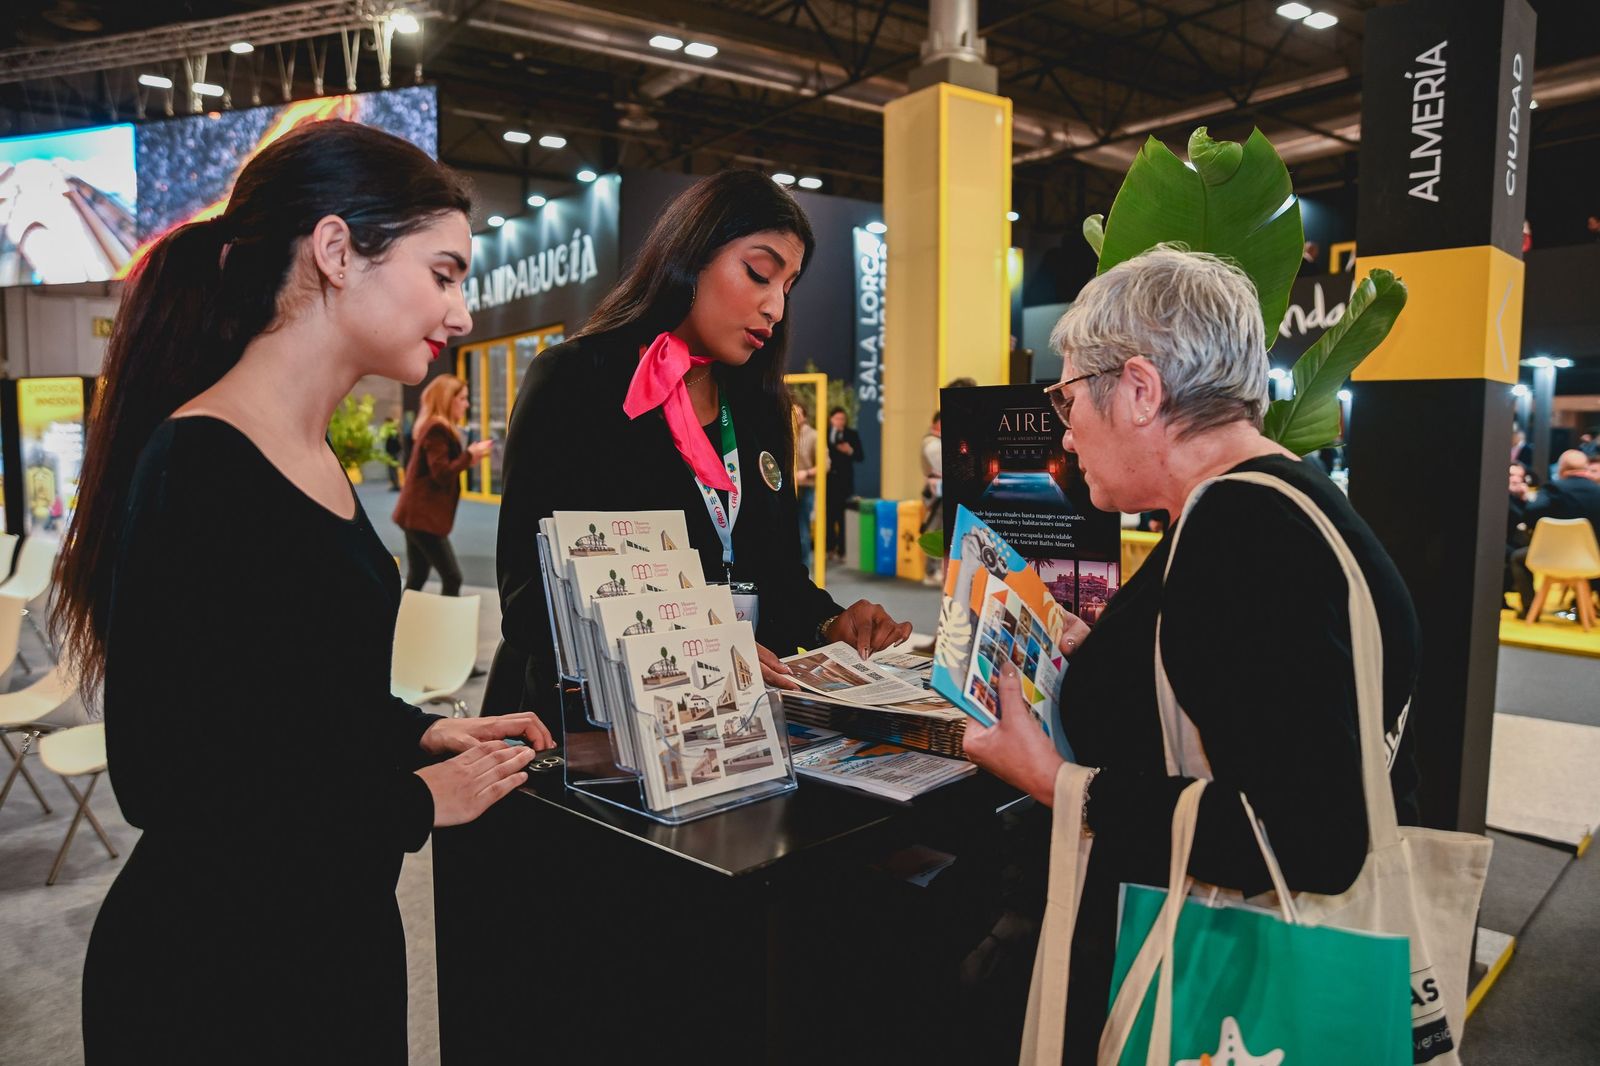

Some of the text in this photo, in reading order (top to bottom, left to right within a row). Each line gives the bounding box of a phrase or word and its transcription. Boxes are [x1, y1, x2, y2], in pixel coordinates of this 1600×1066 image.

[1404, 40, 1448, 202] ALMERÍA
[1506, 53, 1522, 196] CIUDAD
[859, 335, 879, 401] SALA
[998, 412, 1051, 432] AIRE
